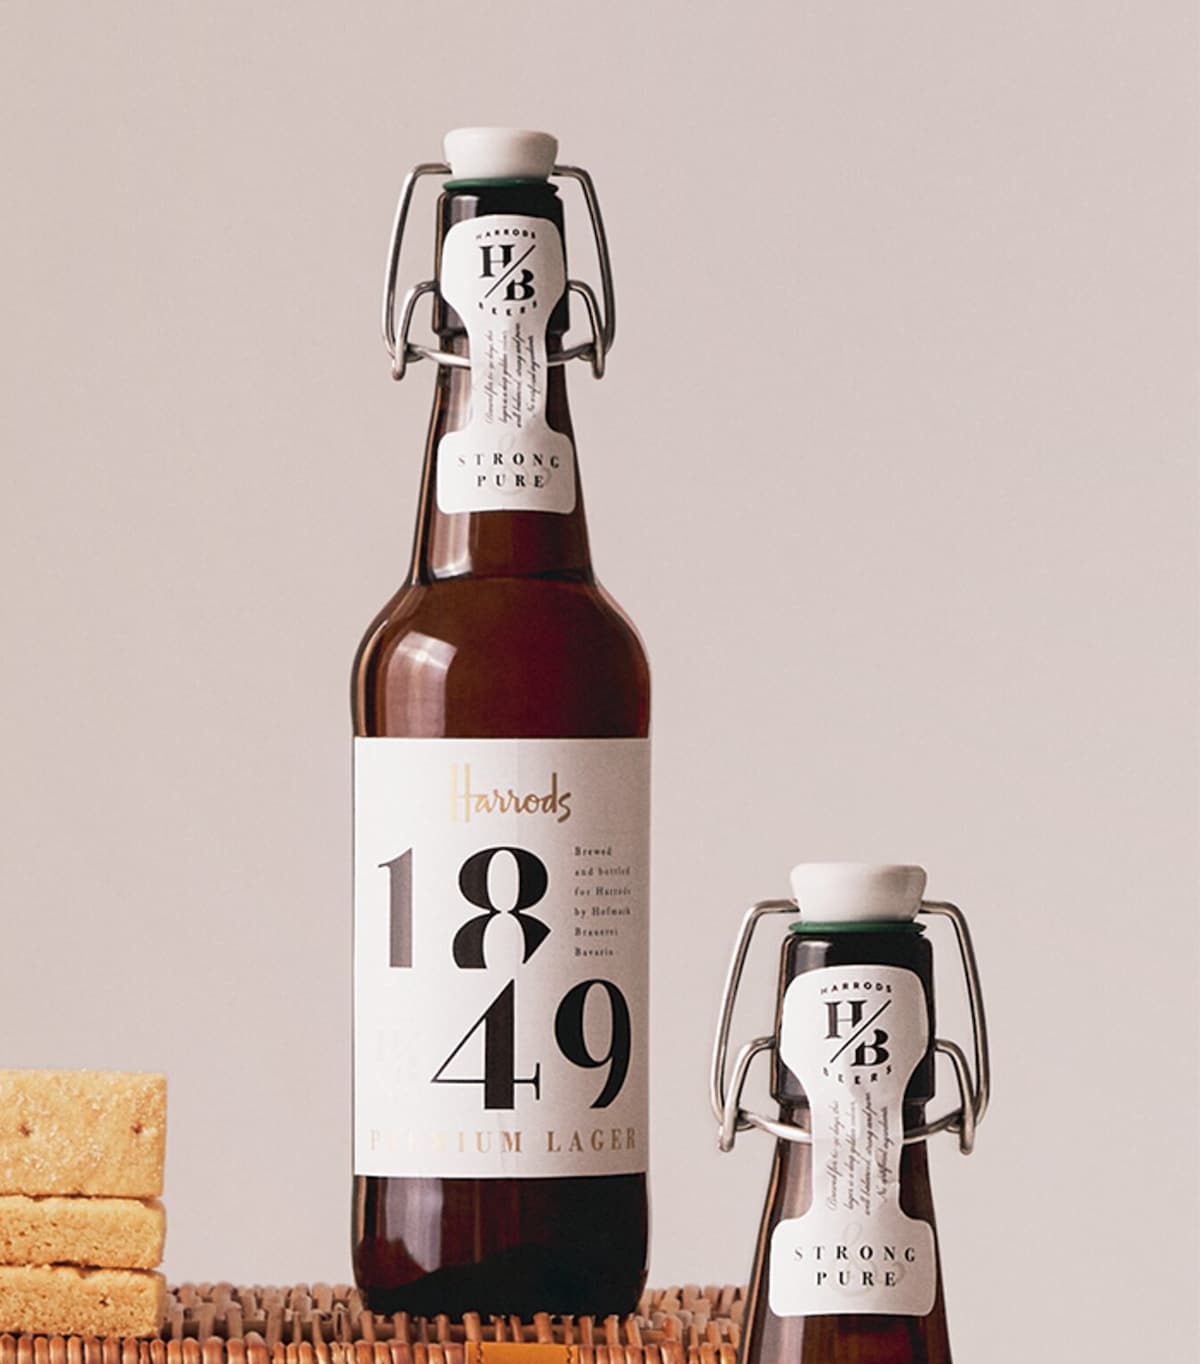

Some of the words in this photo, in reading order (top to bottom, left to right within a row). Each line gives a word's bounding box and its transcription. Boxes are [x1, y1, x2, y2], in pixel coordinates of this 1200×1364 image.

[458, 452, 560, 469] STRONG
[477, 474, 544, 488] PURE
[447, 763, 572, 823] Harrods
[820, 982, 892, 994] HARRODS
[369, 1129, 522, 1153] PIUM
[546, 1127, 636, 1152] LAGER
[794, 1245, 916, 1262] STRONG
[816, 1271, 897, 1287] PURE
